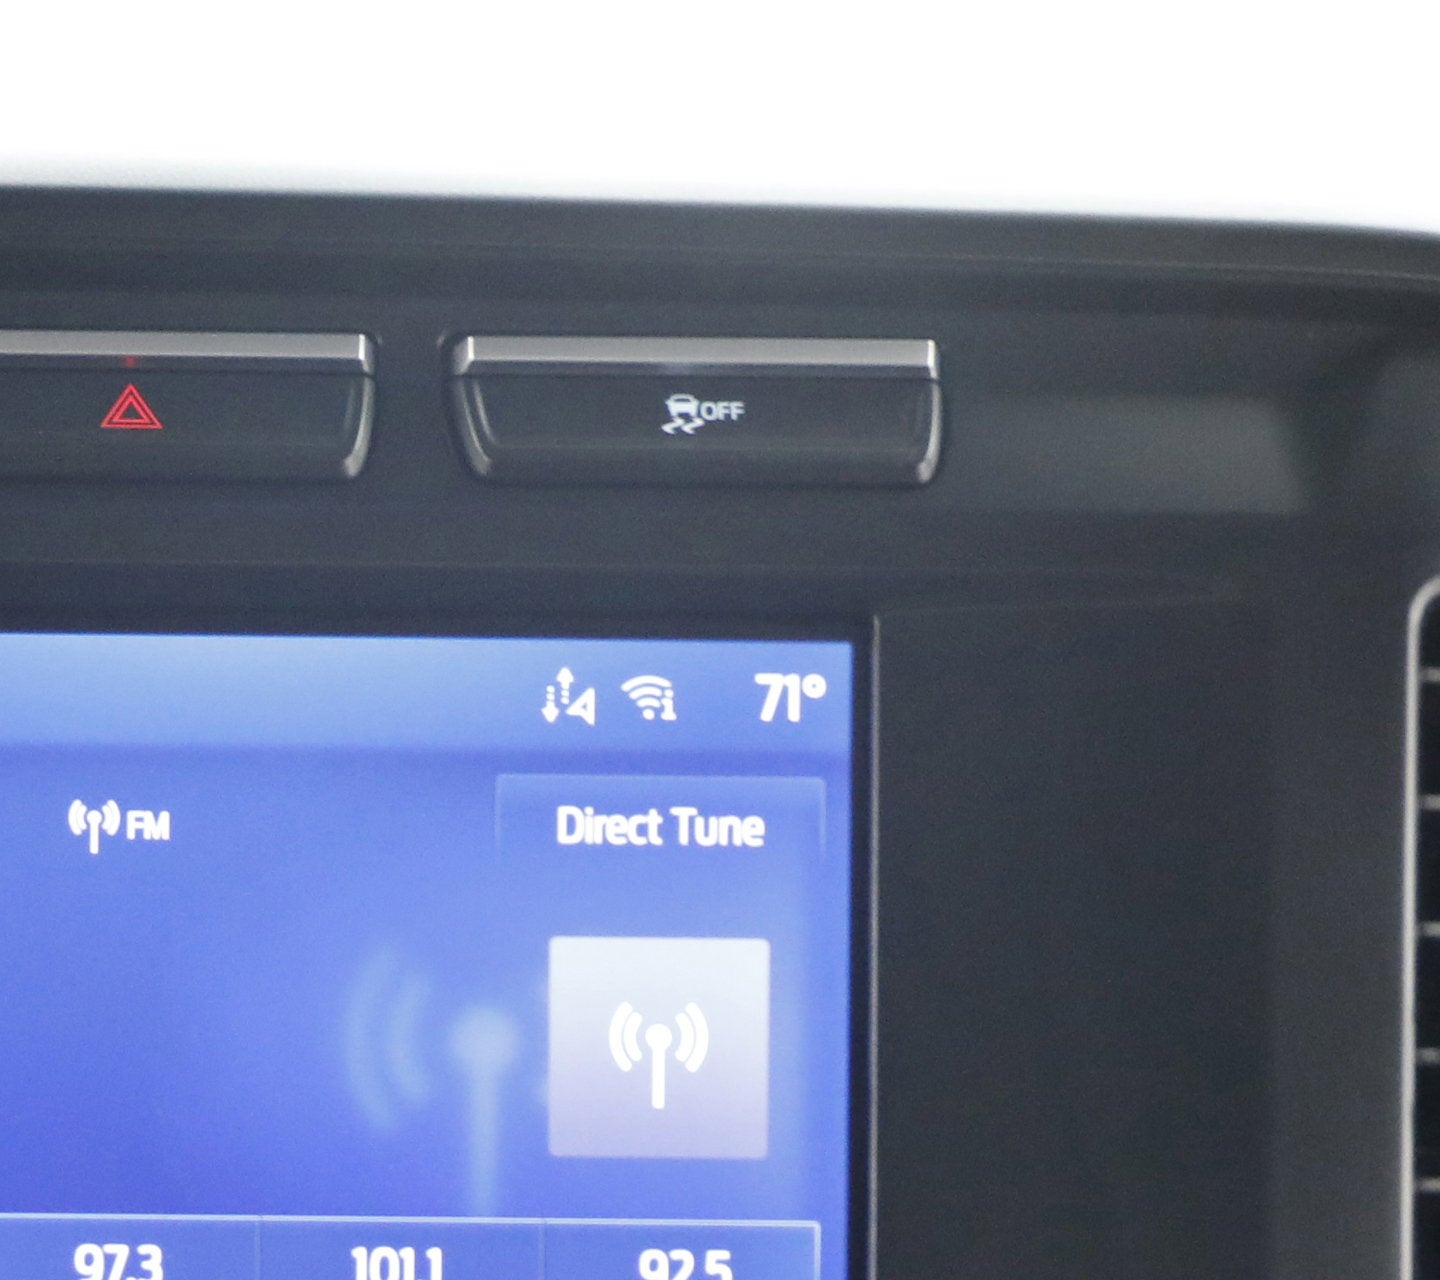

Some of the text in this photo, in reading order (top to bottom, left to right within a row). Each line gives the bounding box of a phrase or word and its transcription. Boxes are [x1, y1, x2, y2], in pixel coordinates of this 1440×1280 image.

[700, 401, 745, 420] OFF
[126, 810, 170, 841] FM
[556, 806, 765, 847] Direct Tune
